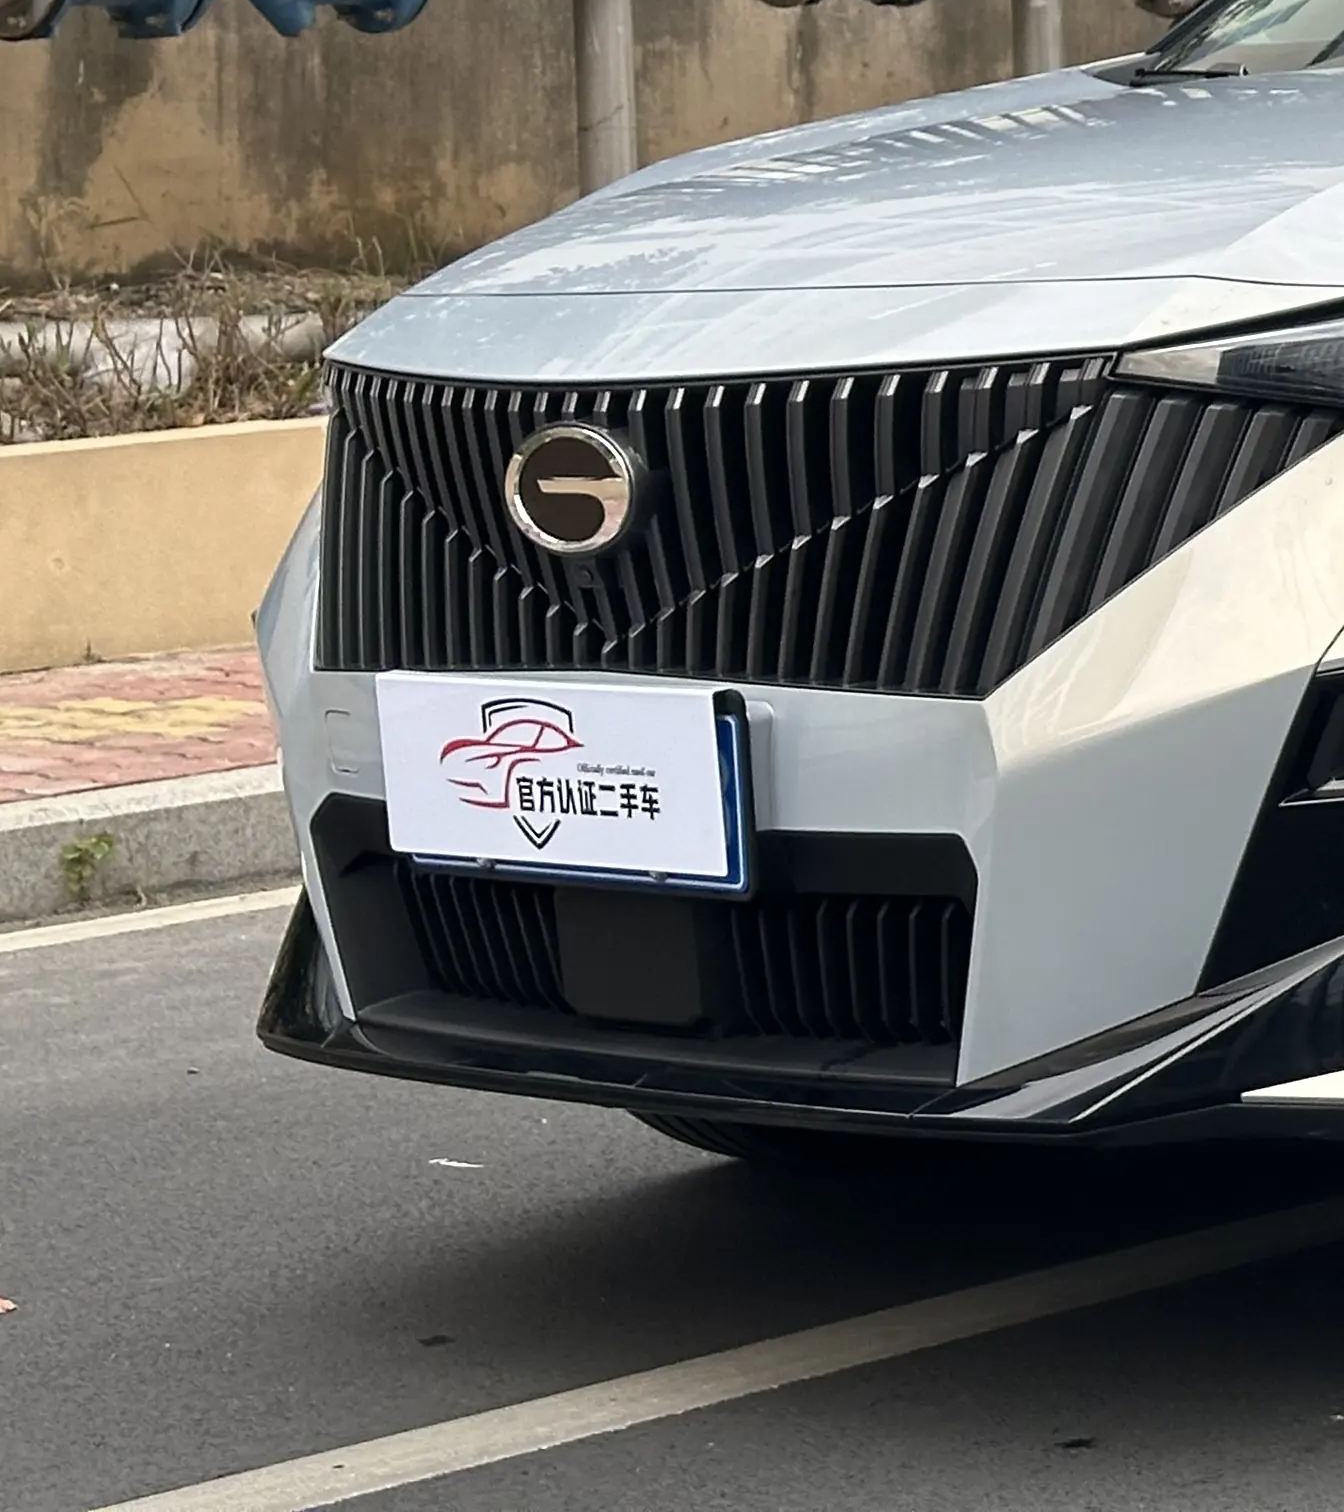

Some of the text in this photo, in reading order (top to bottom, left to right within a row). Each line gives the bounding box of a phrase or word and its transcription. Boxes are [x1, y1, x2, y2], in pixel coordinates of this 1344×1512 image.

[516, 776, 661, 820] 官方认证二手车
